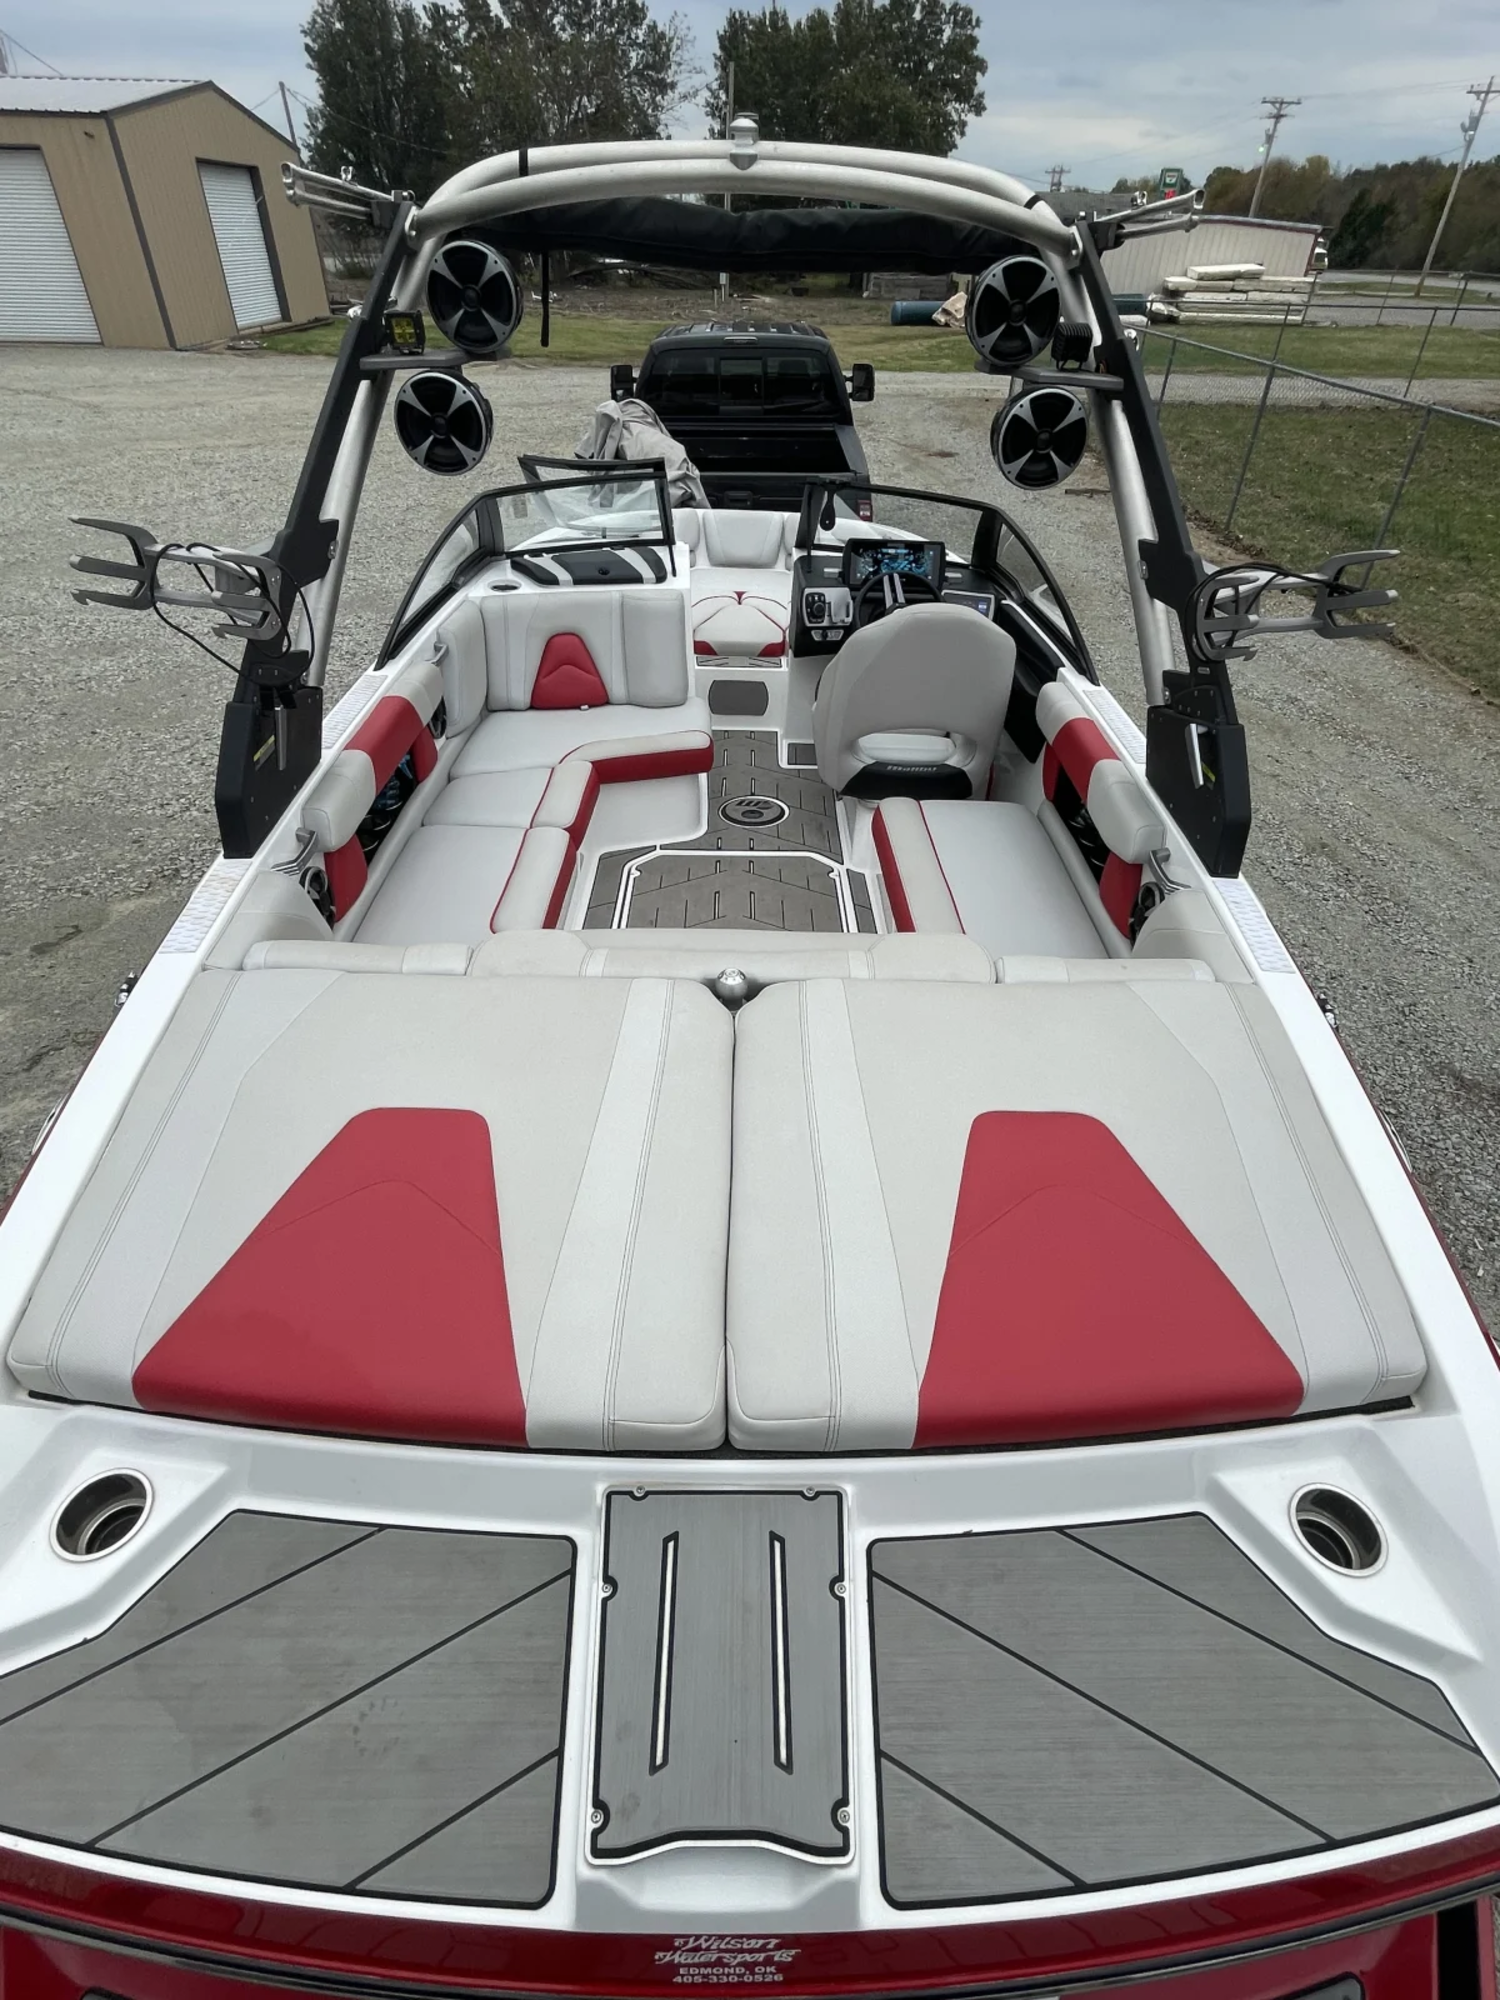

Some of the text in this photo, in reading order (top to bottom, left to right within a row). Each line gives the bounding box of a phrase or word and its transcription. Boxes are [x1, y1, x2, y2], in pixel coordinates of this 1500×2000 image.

[674, 1936, 781, 1951] Wilson
[654, 1950, 801, 1966] Watersports
[679, 1966, 777, 1975] EDMOND, OK
[672, 1974, 784, 1983] 405-330-0526
